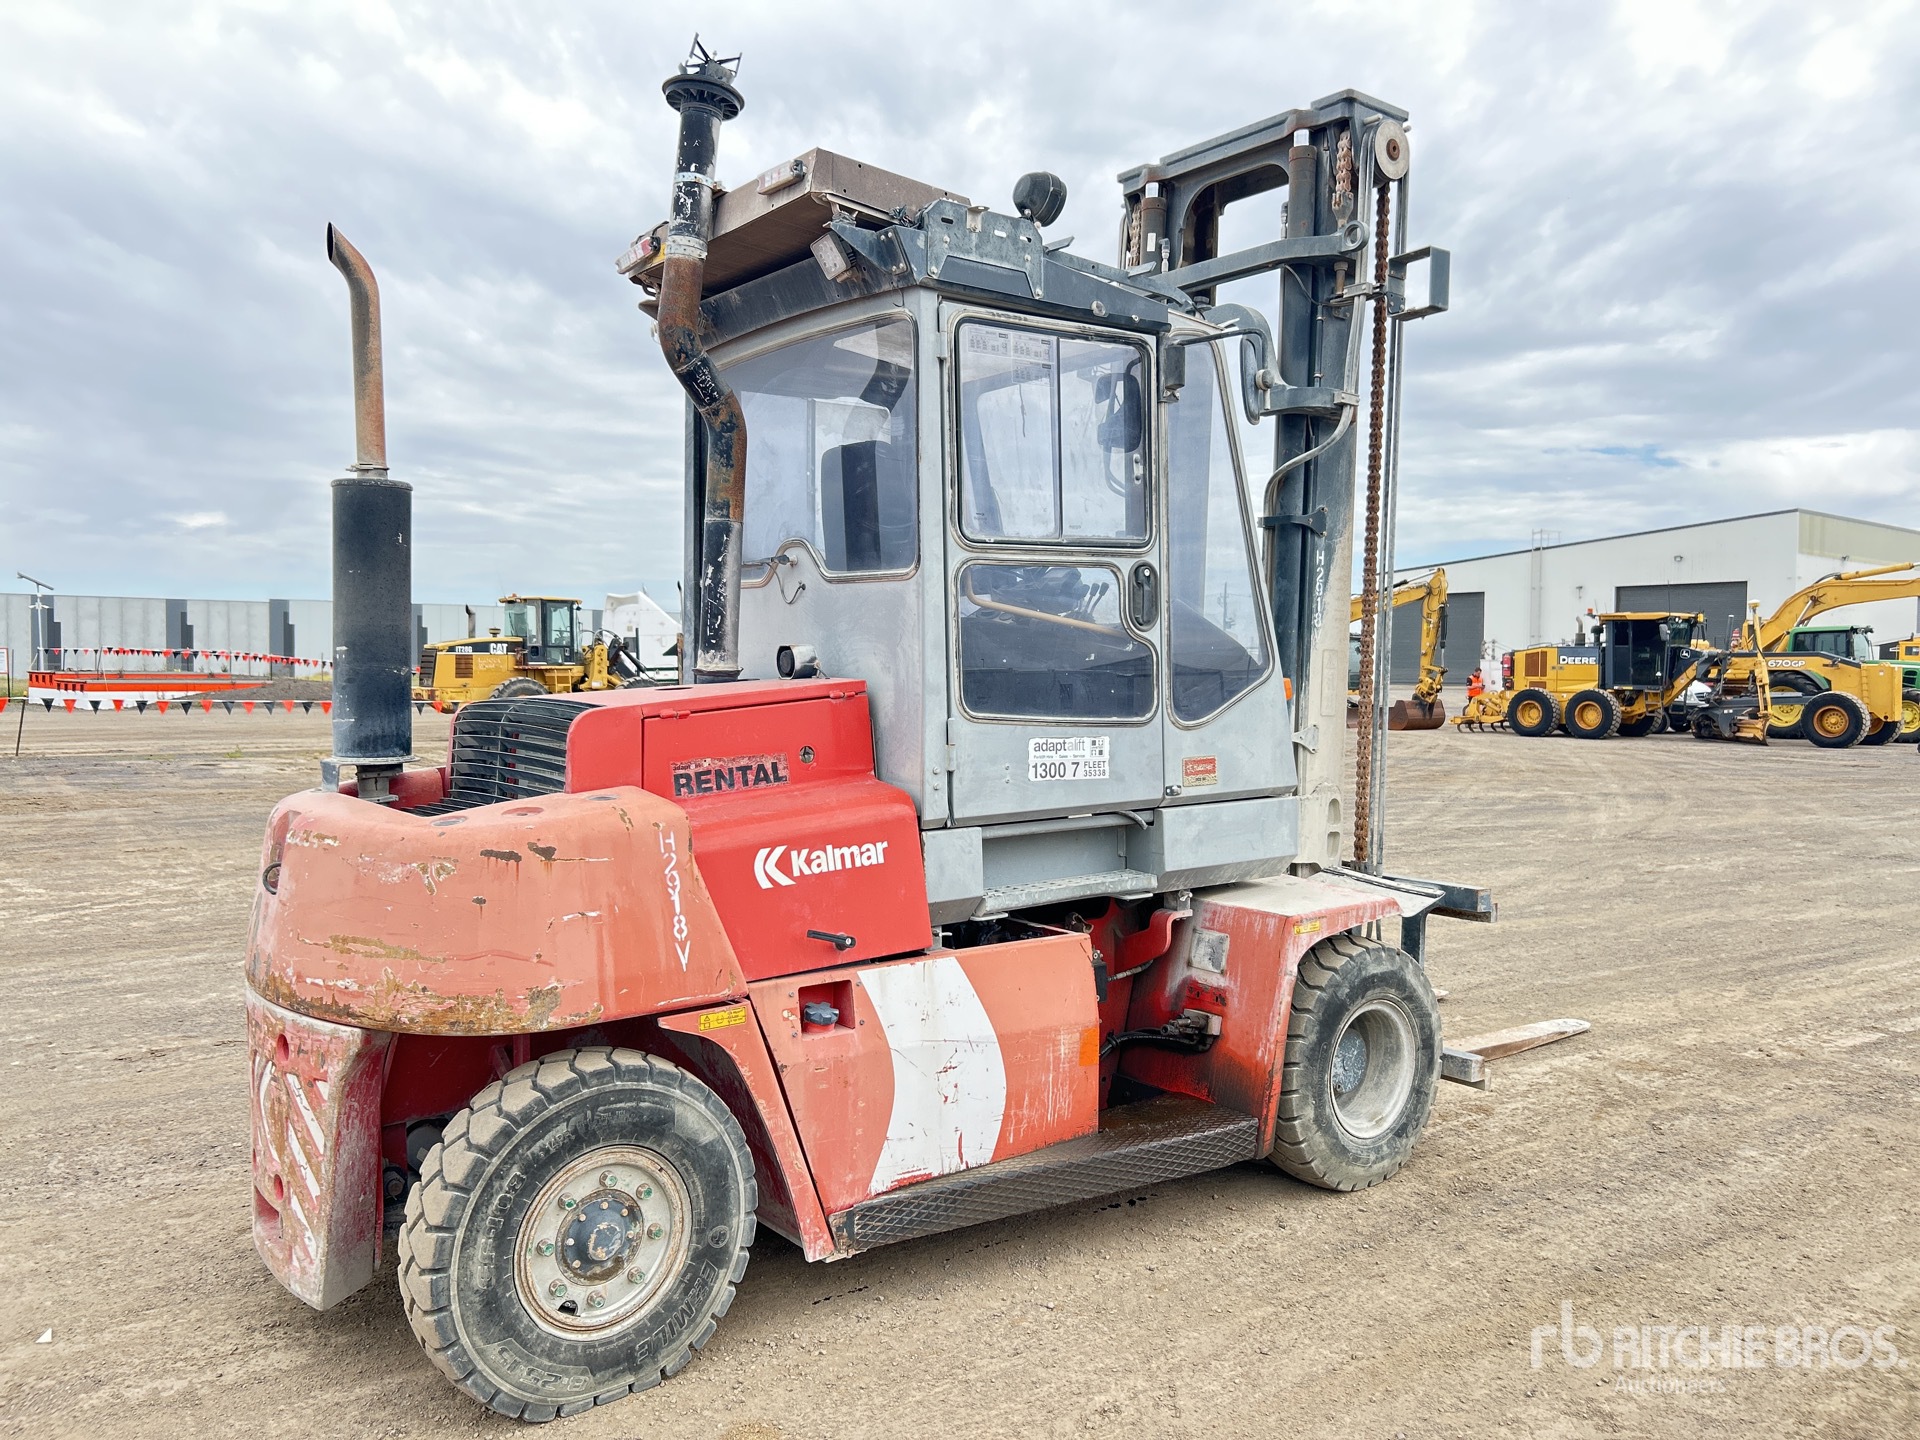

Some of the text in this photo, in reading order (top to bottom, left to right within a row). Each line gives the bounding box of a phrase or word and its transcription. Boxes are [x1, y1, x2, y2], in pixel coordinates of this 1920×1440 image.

[489, 643, 508, 654] CAT
[1559, 655, 1597, 665] DEERE
[1767, 659, 1806, 667] 670GP
[1033, 738, 1086, 754] adaptalift
[1032, 761, 1080, 779] 1300 7
[1083, 760, 1107, 769] FLEET
[673, 761, 788, 797] RENTAL
[1083, 769, 1107, 778] 35338
[790, 840, 888, 878] Kalmar
